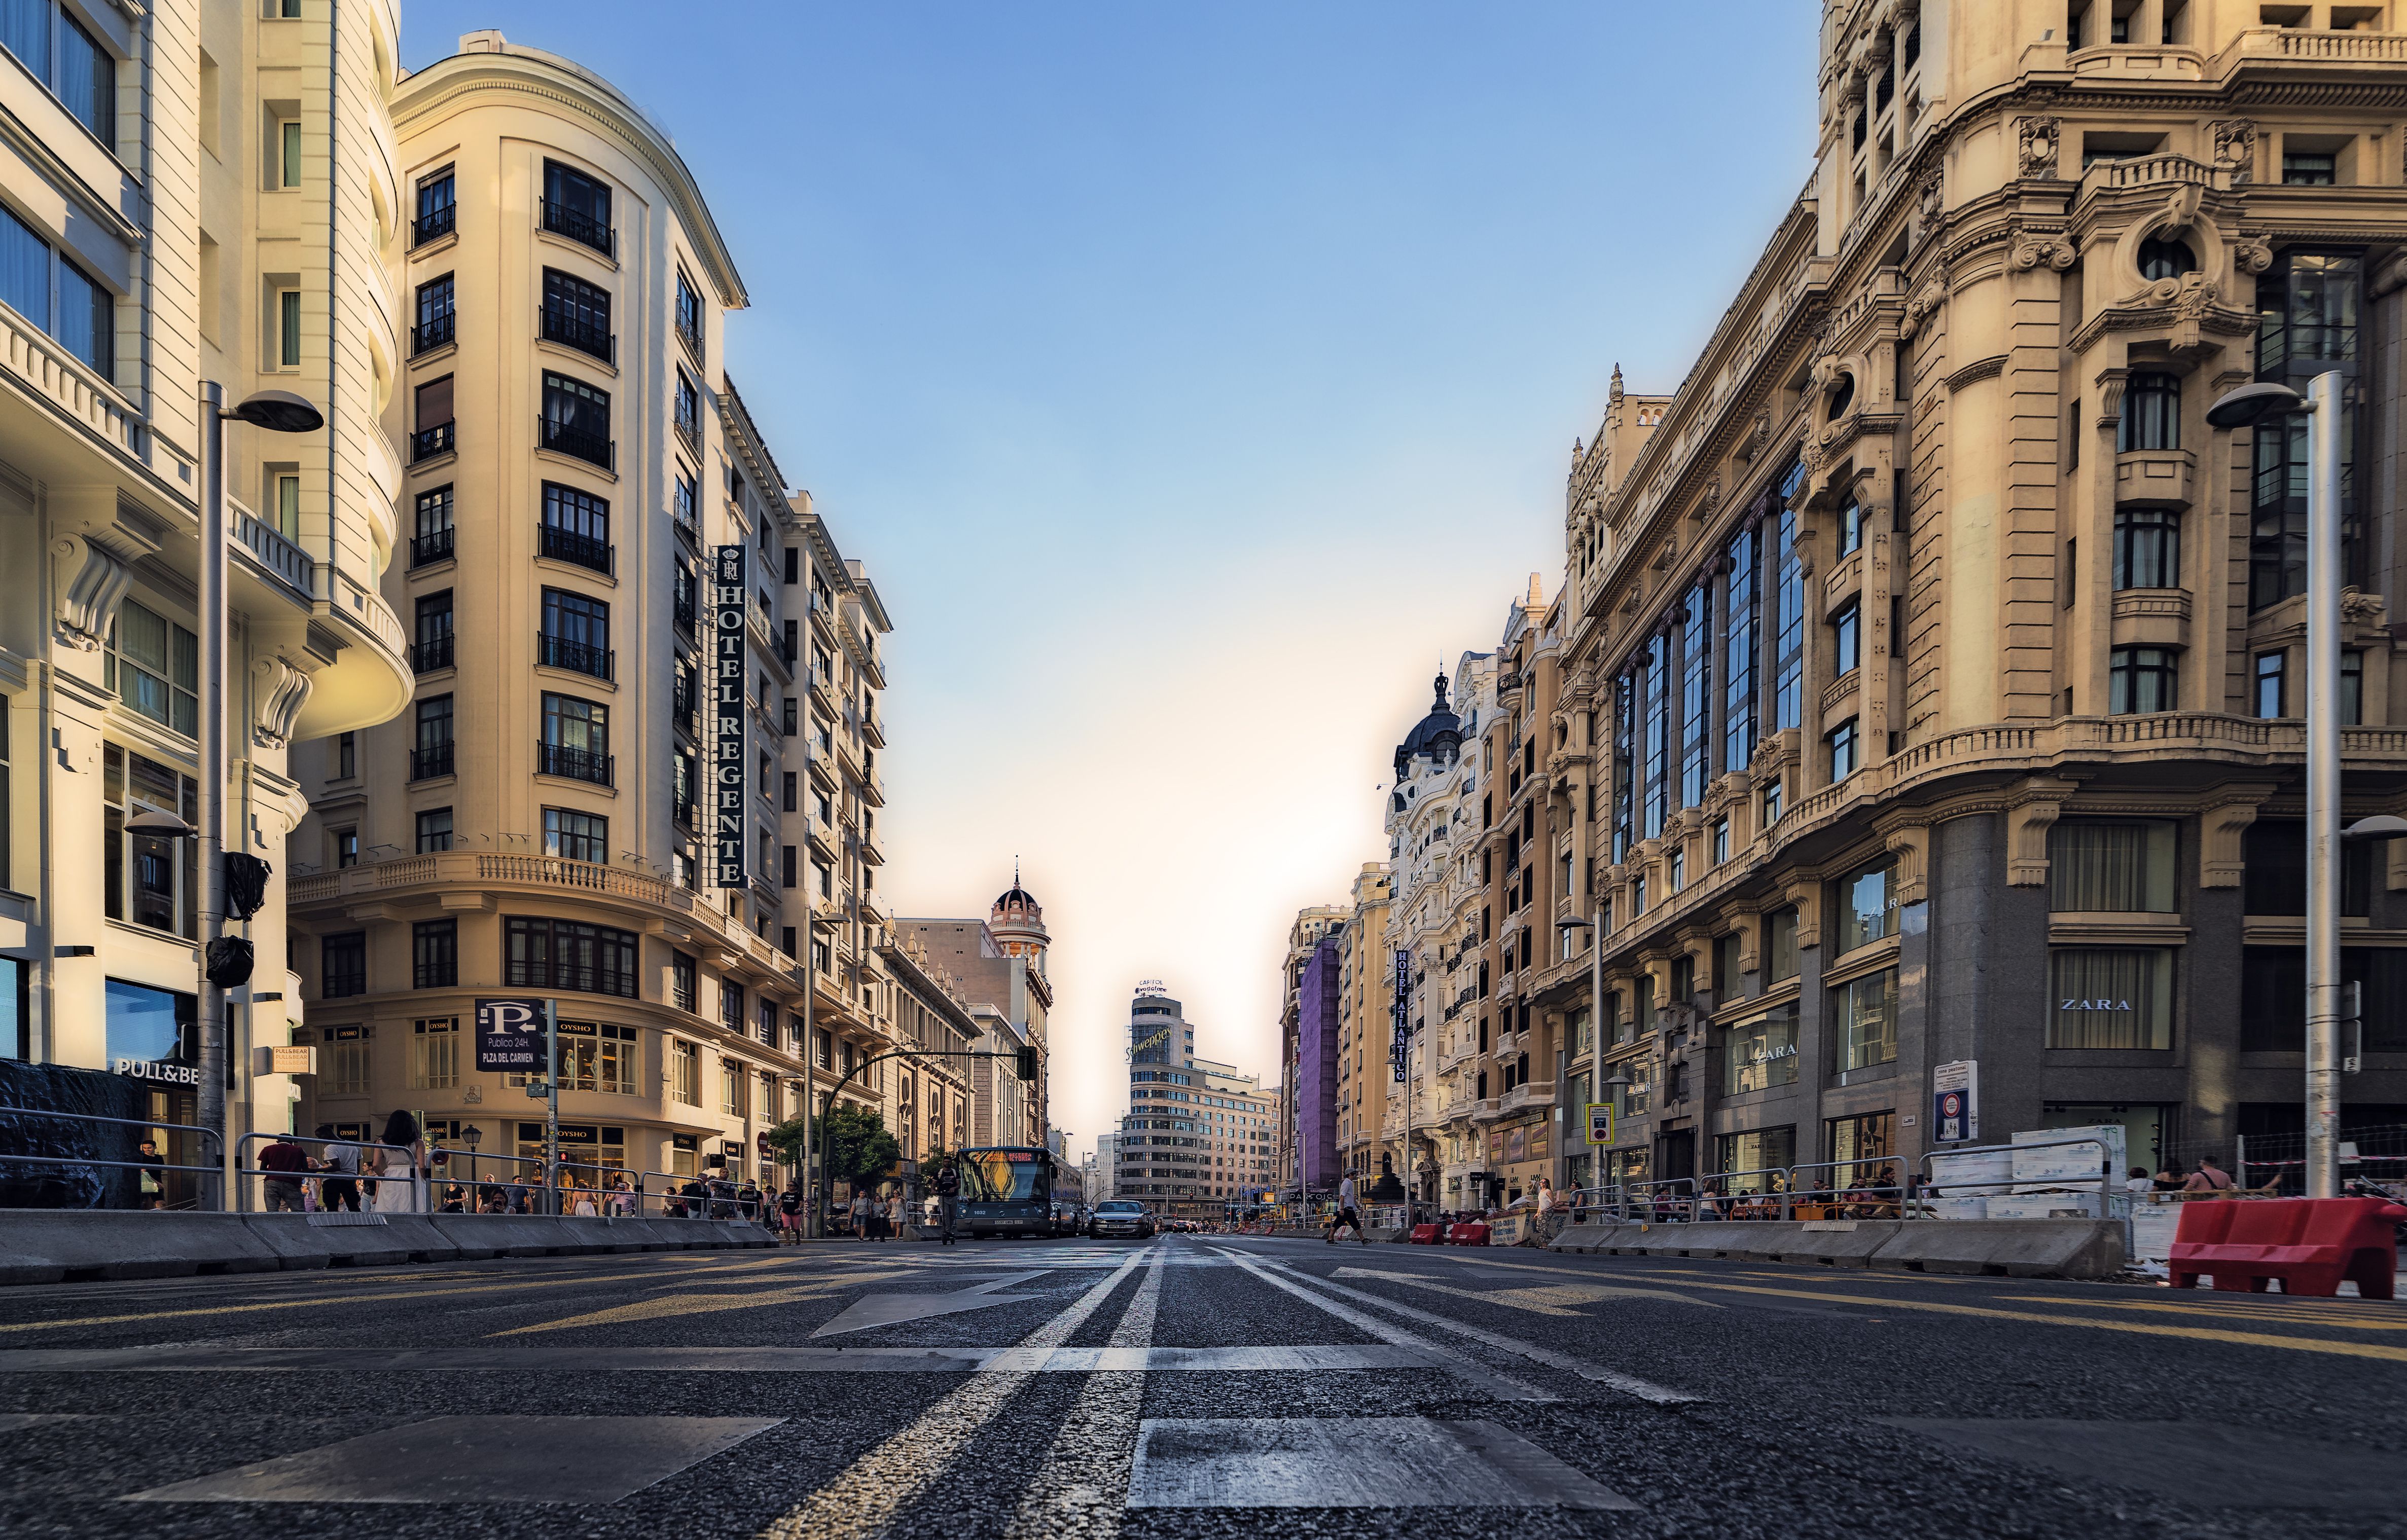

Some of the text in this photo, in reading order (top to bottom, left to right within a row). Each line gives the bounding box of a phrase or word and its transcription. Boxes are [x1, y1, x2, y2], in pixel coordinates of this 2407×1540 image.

[717, 586, 743, 882] HOTEL REGENTE
[1869, 898, 1898, 918] ZAR
[2061, 999, 2132, 1010] ZARA
[486, 1006, 532, 1034] P
[1396, 952, 1407, 1080] HOTEL ATLANTICO
[560, 1024, 591, 1032] OYSHO
[488, 1038, 529, 1047] Publico 24H.
[1126, 1026, 1173, 1061] Schweppes
[483, 1053, 533, 1062] PLZA DEL CARMEN
[1757, 1044, 1797, 1064] ZARA
[114, 1058, 199, 1085] PULL&BE
[1948, 1065, 1966, 1073] peatonal
[1634, 1083, 1651, 1094] ZAR
